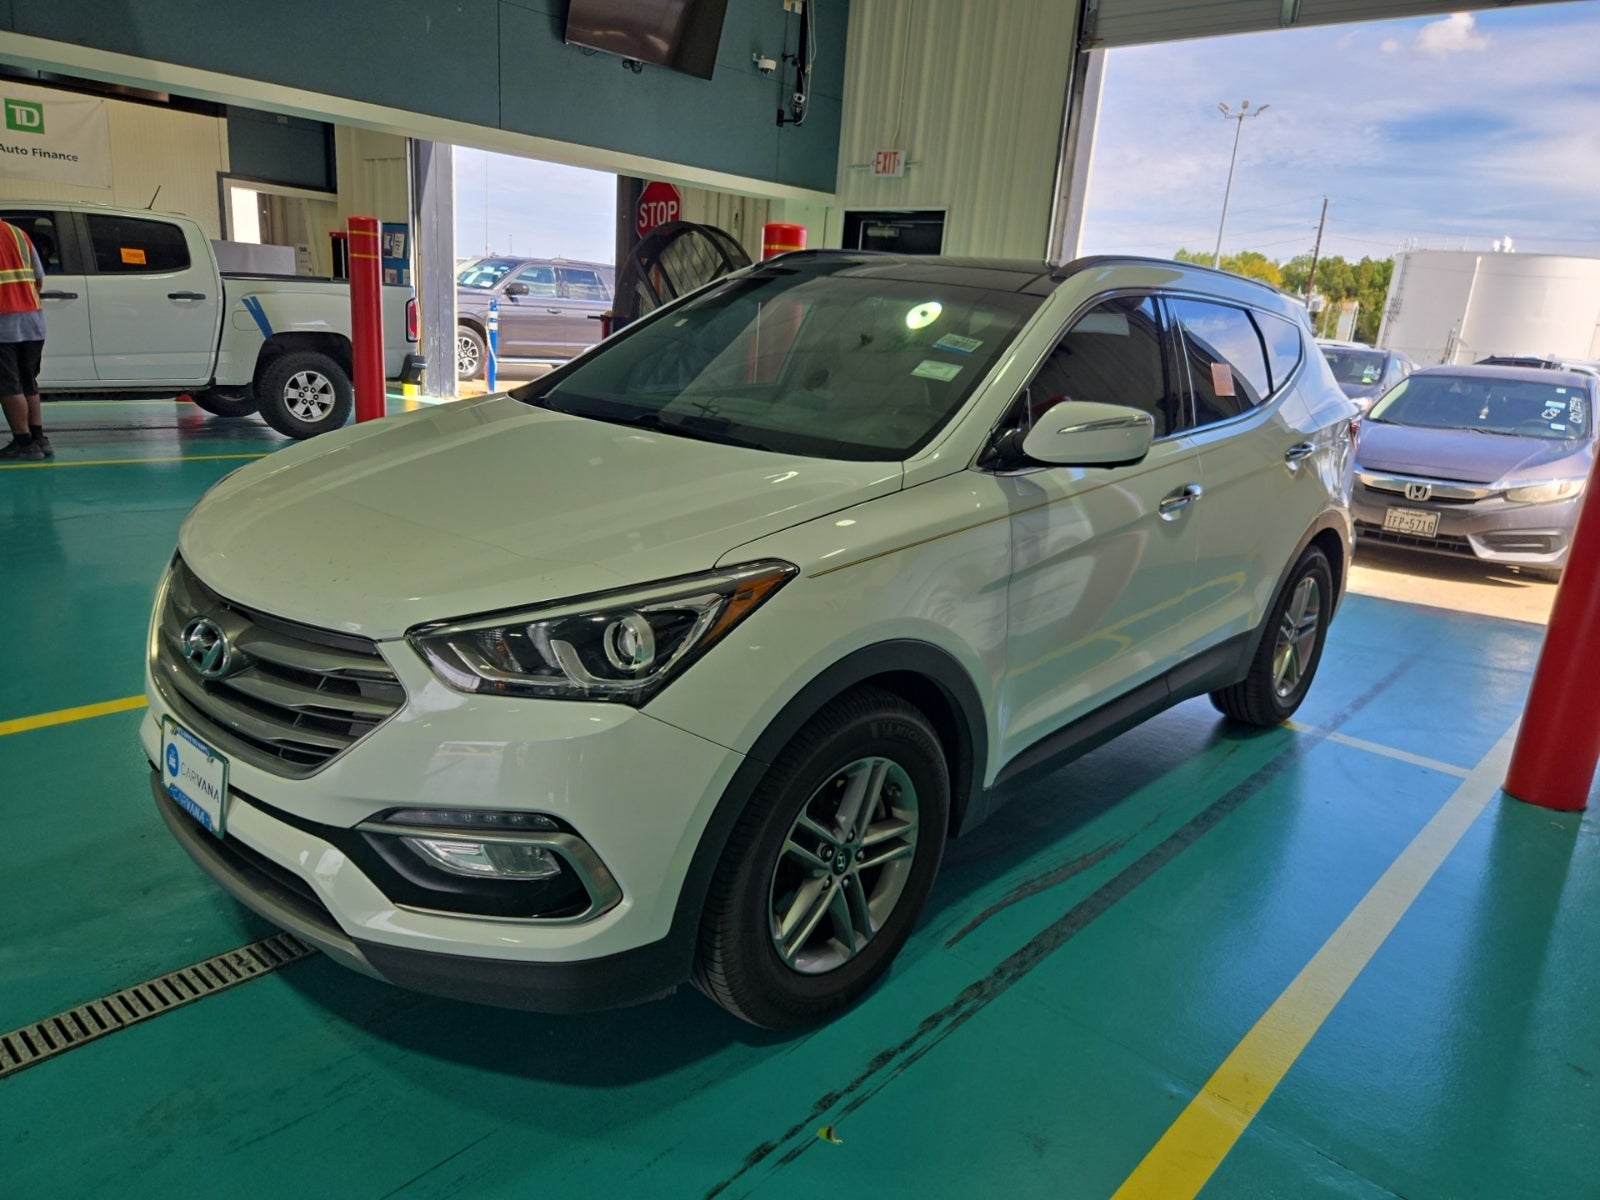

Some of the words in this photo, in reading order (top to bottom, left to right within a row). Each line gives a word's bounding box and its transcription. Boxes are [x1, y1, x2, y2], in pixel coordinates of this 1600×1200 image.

[8, 104, 40, 128] TD
[0, 143, 28, 155] Auto
[32, 147, 79, 162] Finance
[875, 151, 899, 175] EXIT
[639, 201, 678, 227] STOP
[180, 762, 220, 804] CARVANA
